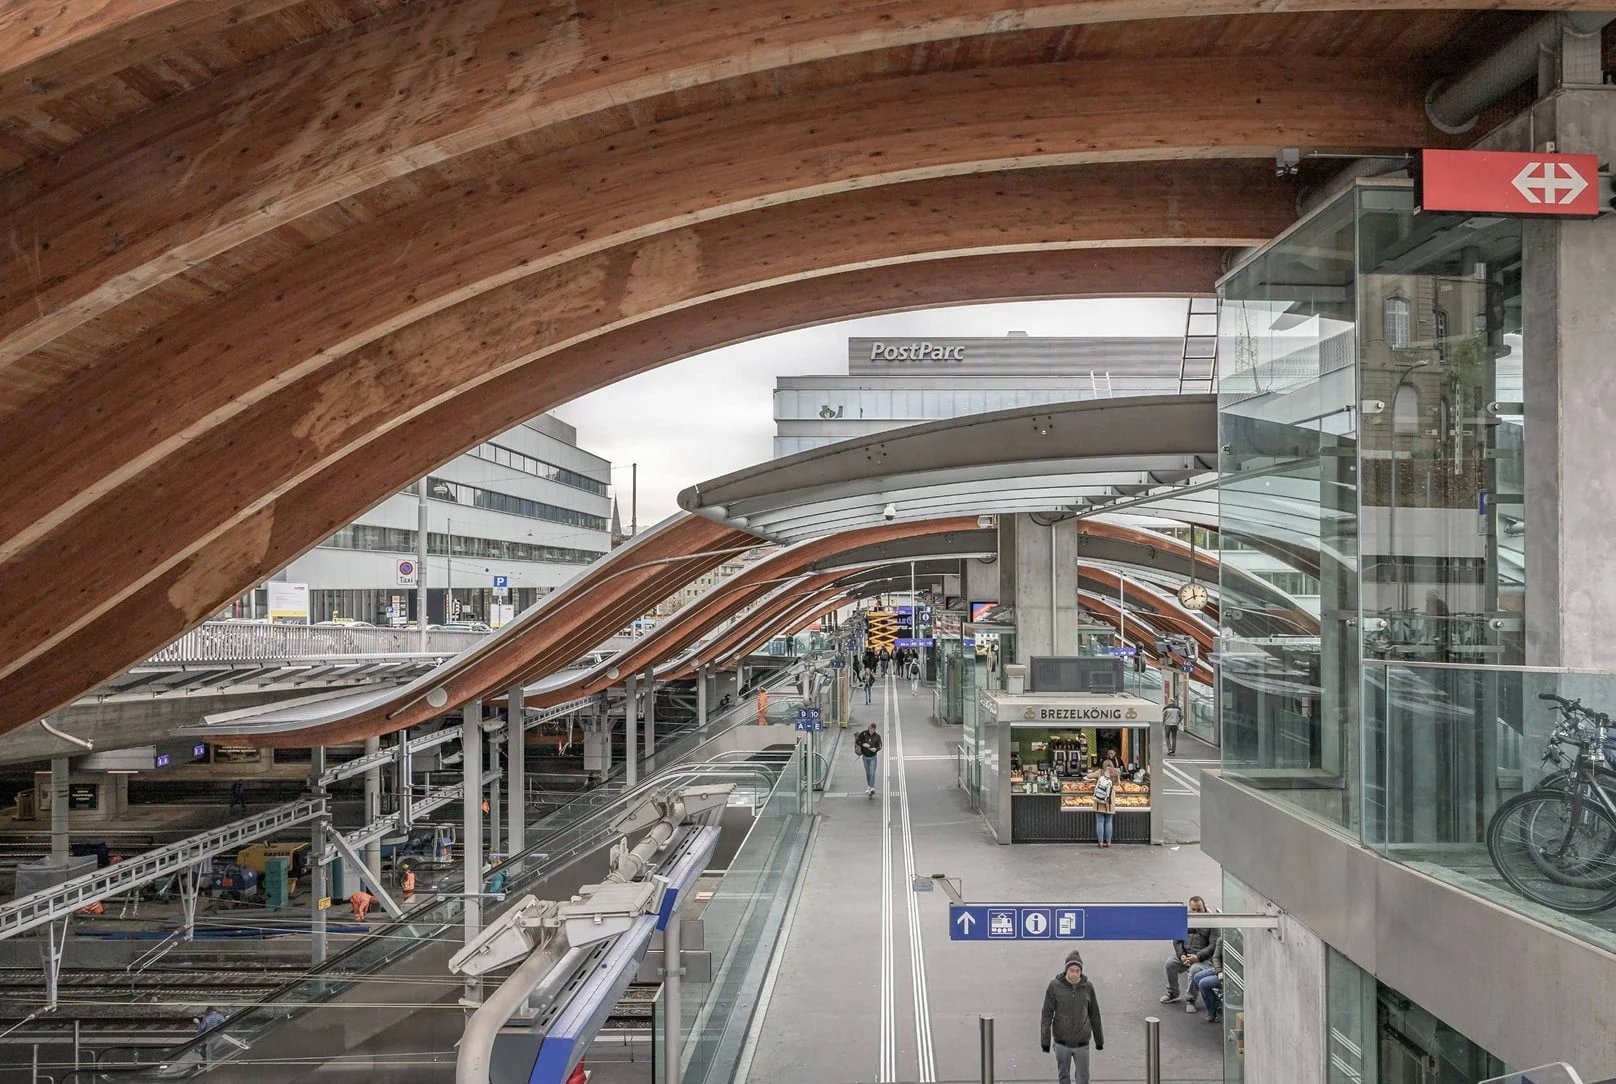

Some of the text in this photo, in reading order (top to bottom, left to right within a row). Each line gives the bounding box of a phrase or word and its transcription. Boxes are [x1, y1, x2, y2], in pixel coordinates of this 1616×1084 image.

[870, 342, 965, 361] PostParc
[399, 576, 413, 584] Taxi
[496, 577, 505, 586] P
[1040, 707, 1121, 719] BREZELKÖNIG
